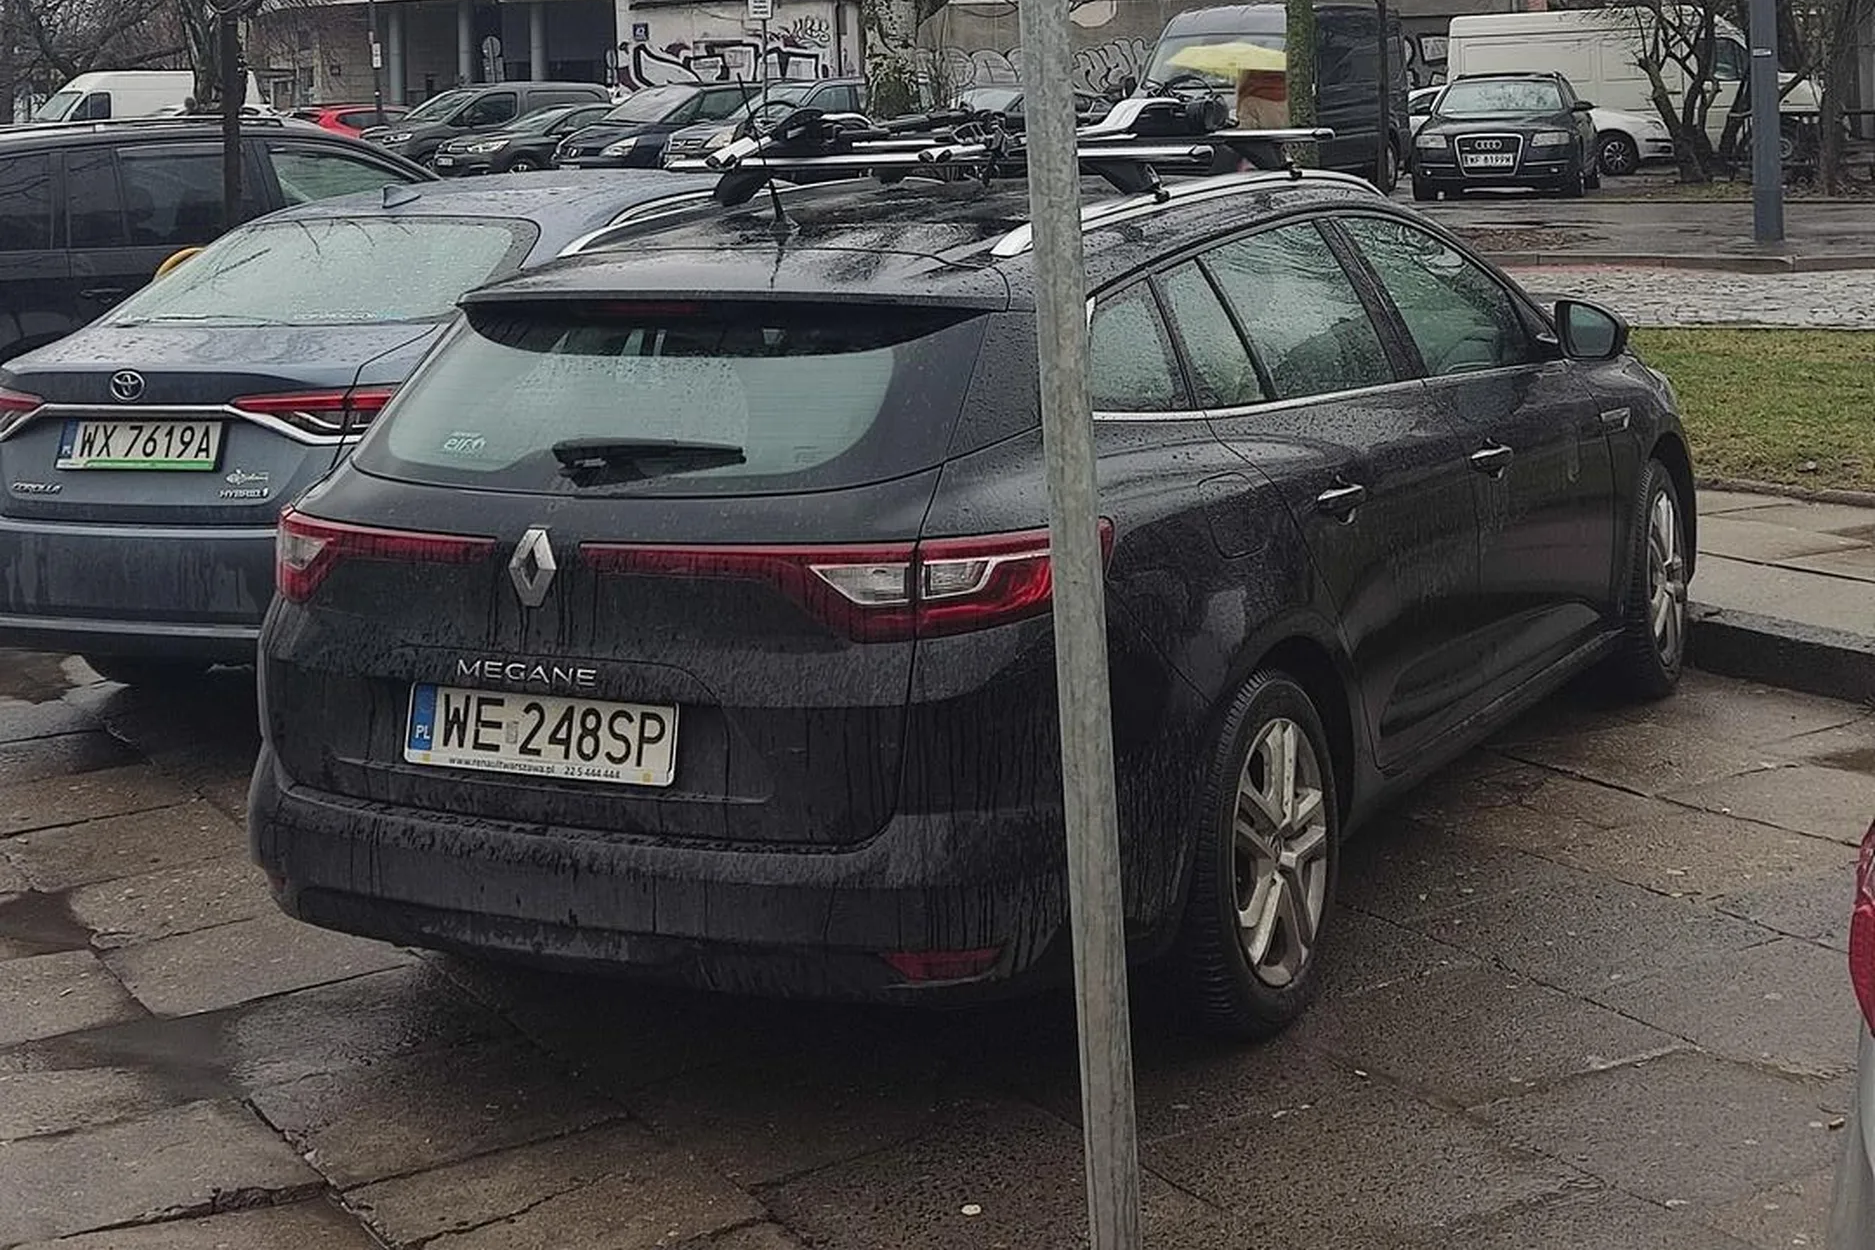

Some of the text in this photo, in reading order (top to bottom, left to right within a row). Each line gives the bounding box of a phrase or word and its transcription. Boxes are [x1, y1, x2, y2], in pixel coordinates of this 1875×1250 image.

[79, 424, 211, 459] WX 7619A
[455, 658, 597, 687] MEGANE
[415, 724, 431, 740] PL
[442, 693, 667, 768] WE 248SP
